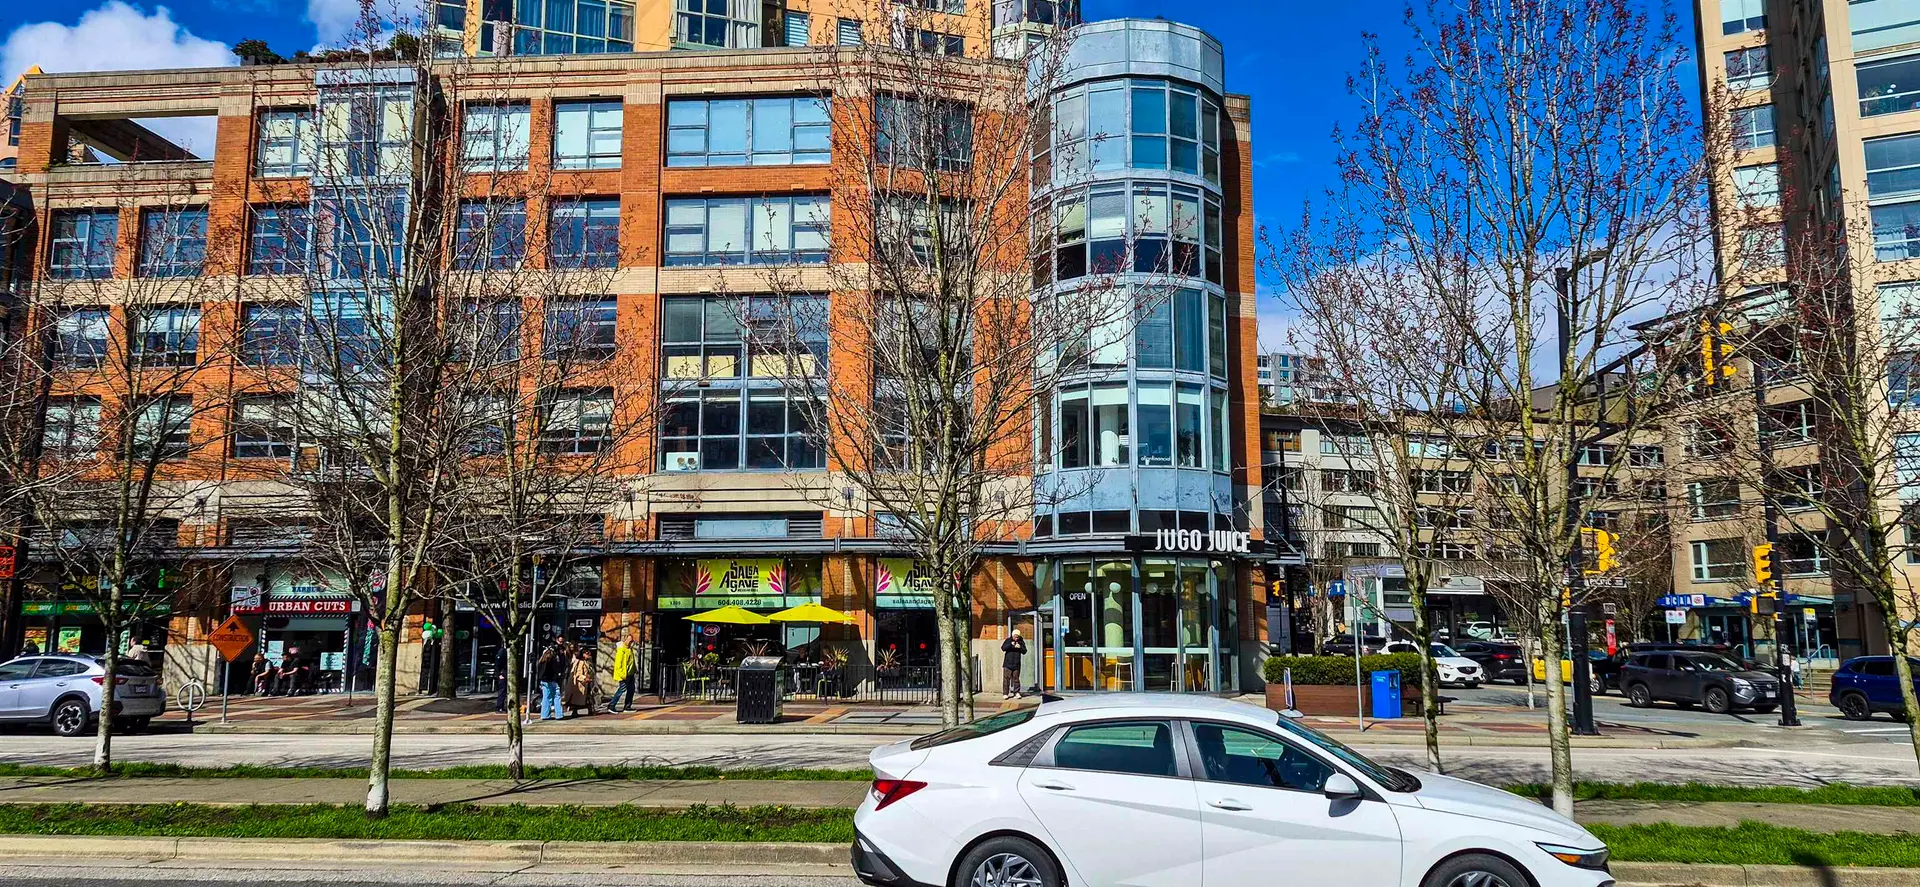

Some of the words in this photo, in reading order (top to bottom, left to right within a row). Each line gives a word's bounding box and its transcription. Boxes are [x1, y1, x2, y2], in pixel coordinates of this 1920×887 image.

[1155, 529, 1202, 551] JUGO
[1207, 530, 1251, 553] JUICE
[730, 560, 759, 579] SALSA
[912, 560, 932, 578] SAL
[719, 571, 759, 592] AGAVE
[903, 569, 933, 592] AGAV
[581, 600, 599, 608] 1207
[1070, 592, 1086, 600] OPEN
[268, 602, 311, 611] URBAN
[314, 601, 346, 611] CUTS
